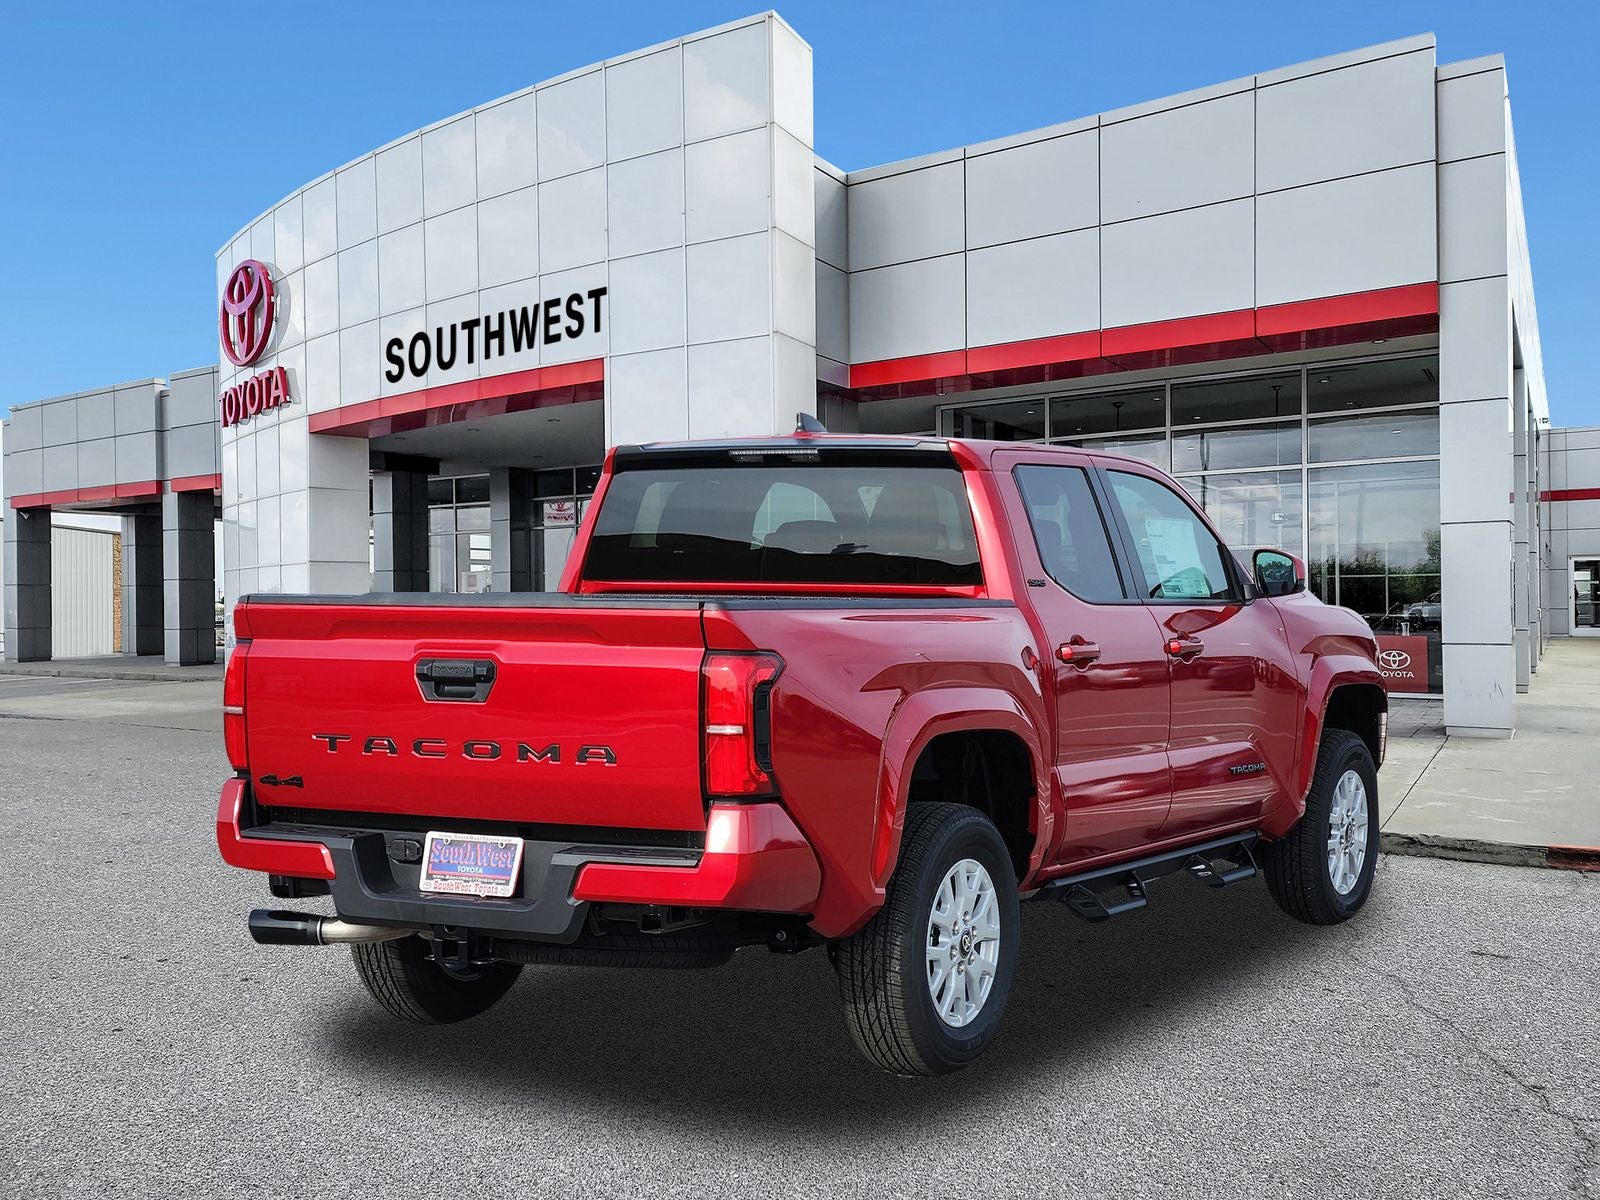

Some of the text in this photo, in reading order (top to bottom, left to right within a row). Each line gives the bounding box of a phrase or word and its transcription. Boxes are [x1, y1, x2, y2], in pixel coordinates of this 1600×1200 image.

[385, 287, 607, 383] SOUTHWEST
[219, 366, 290, 427] TOYOTA
[434, 665, 472, 675] TOYOTA
[312, 733, 617, 767] TACOMA
[1230, 762, 1266, 775] TACOMA
[457, 866, 484, 874] TOYOTA
[474, 883, 499, 895] Toyota
